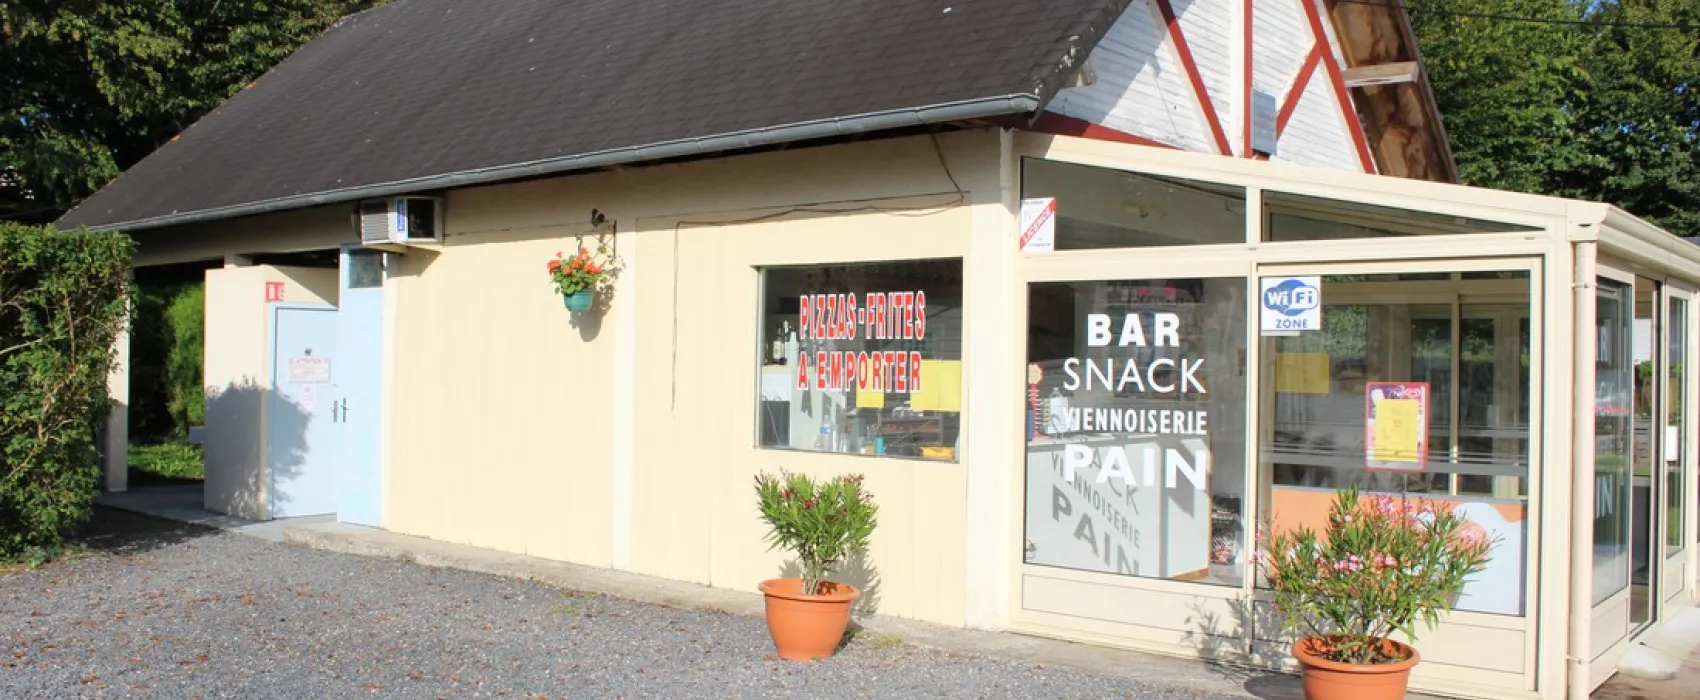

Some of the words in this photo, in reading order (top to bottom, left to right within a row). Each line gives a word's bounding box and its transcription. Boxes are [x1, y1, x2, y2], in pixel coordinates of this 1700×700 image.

[1087, 313, 1180, 347] BAR
[1275, 318, 1307, 329] ZONE
[796, 351, 809, 391] A
[816, 351, 922, 393] EMPORTER
[1063, 357, 1207, 394] SNACK
[1063, 406, 1208, 435] VIENNOISERIE
[1064, 443, 1208, 490] PAIN
[1051, 451, 1140, 549] VINNOISERIE
[1052, 484, 1140, 576] PAIN
